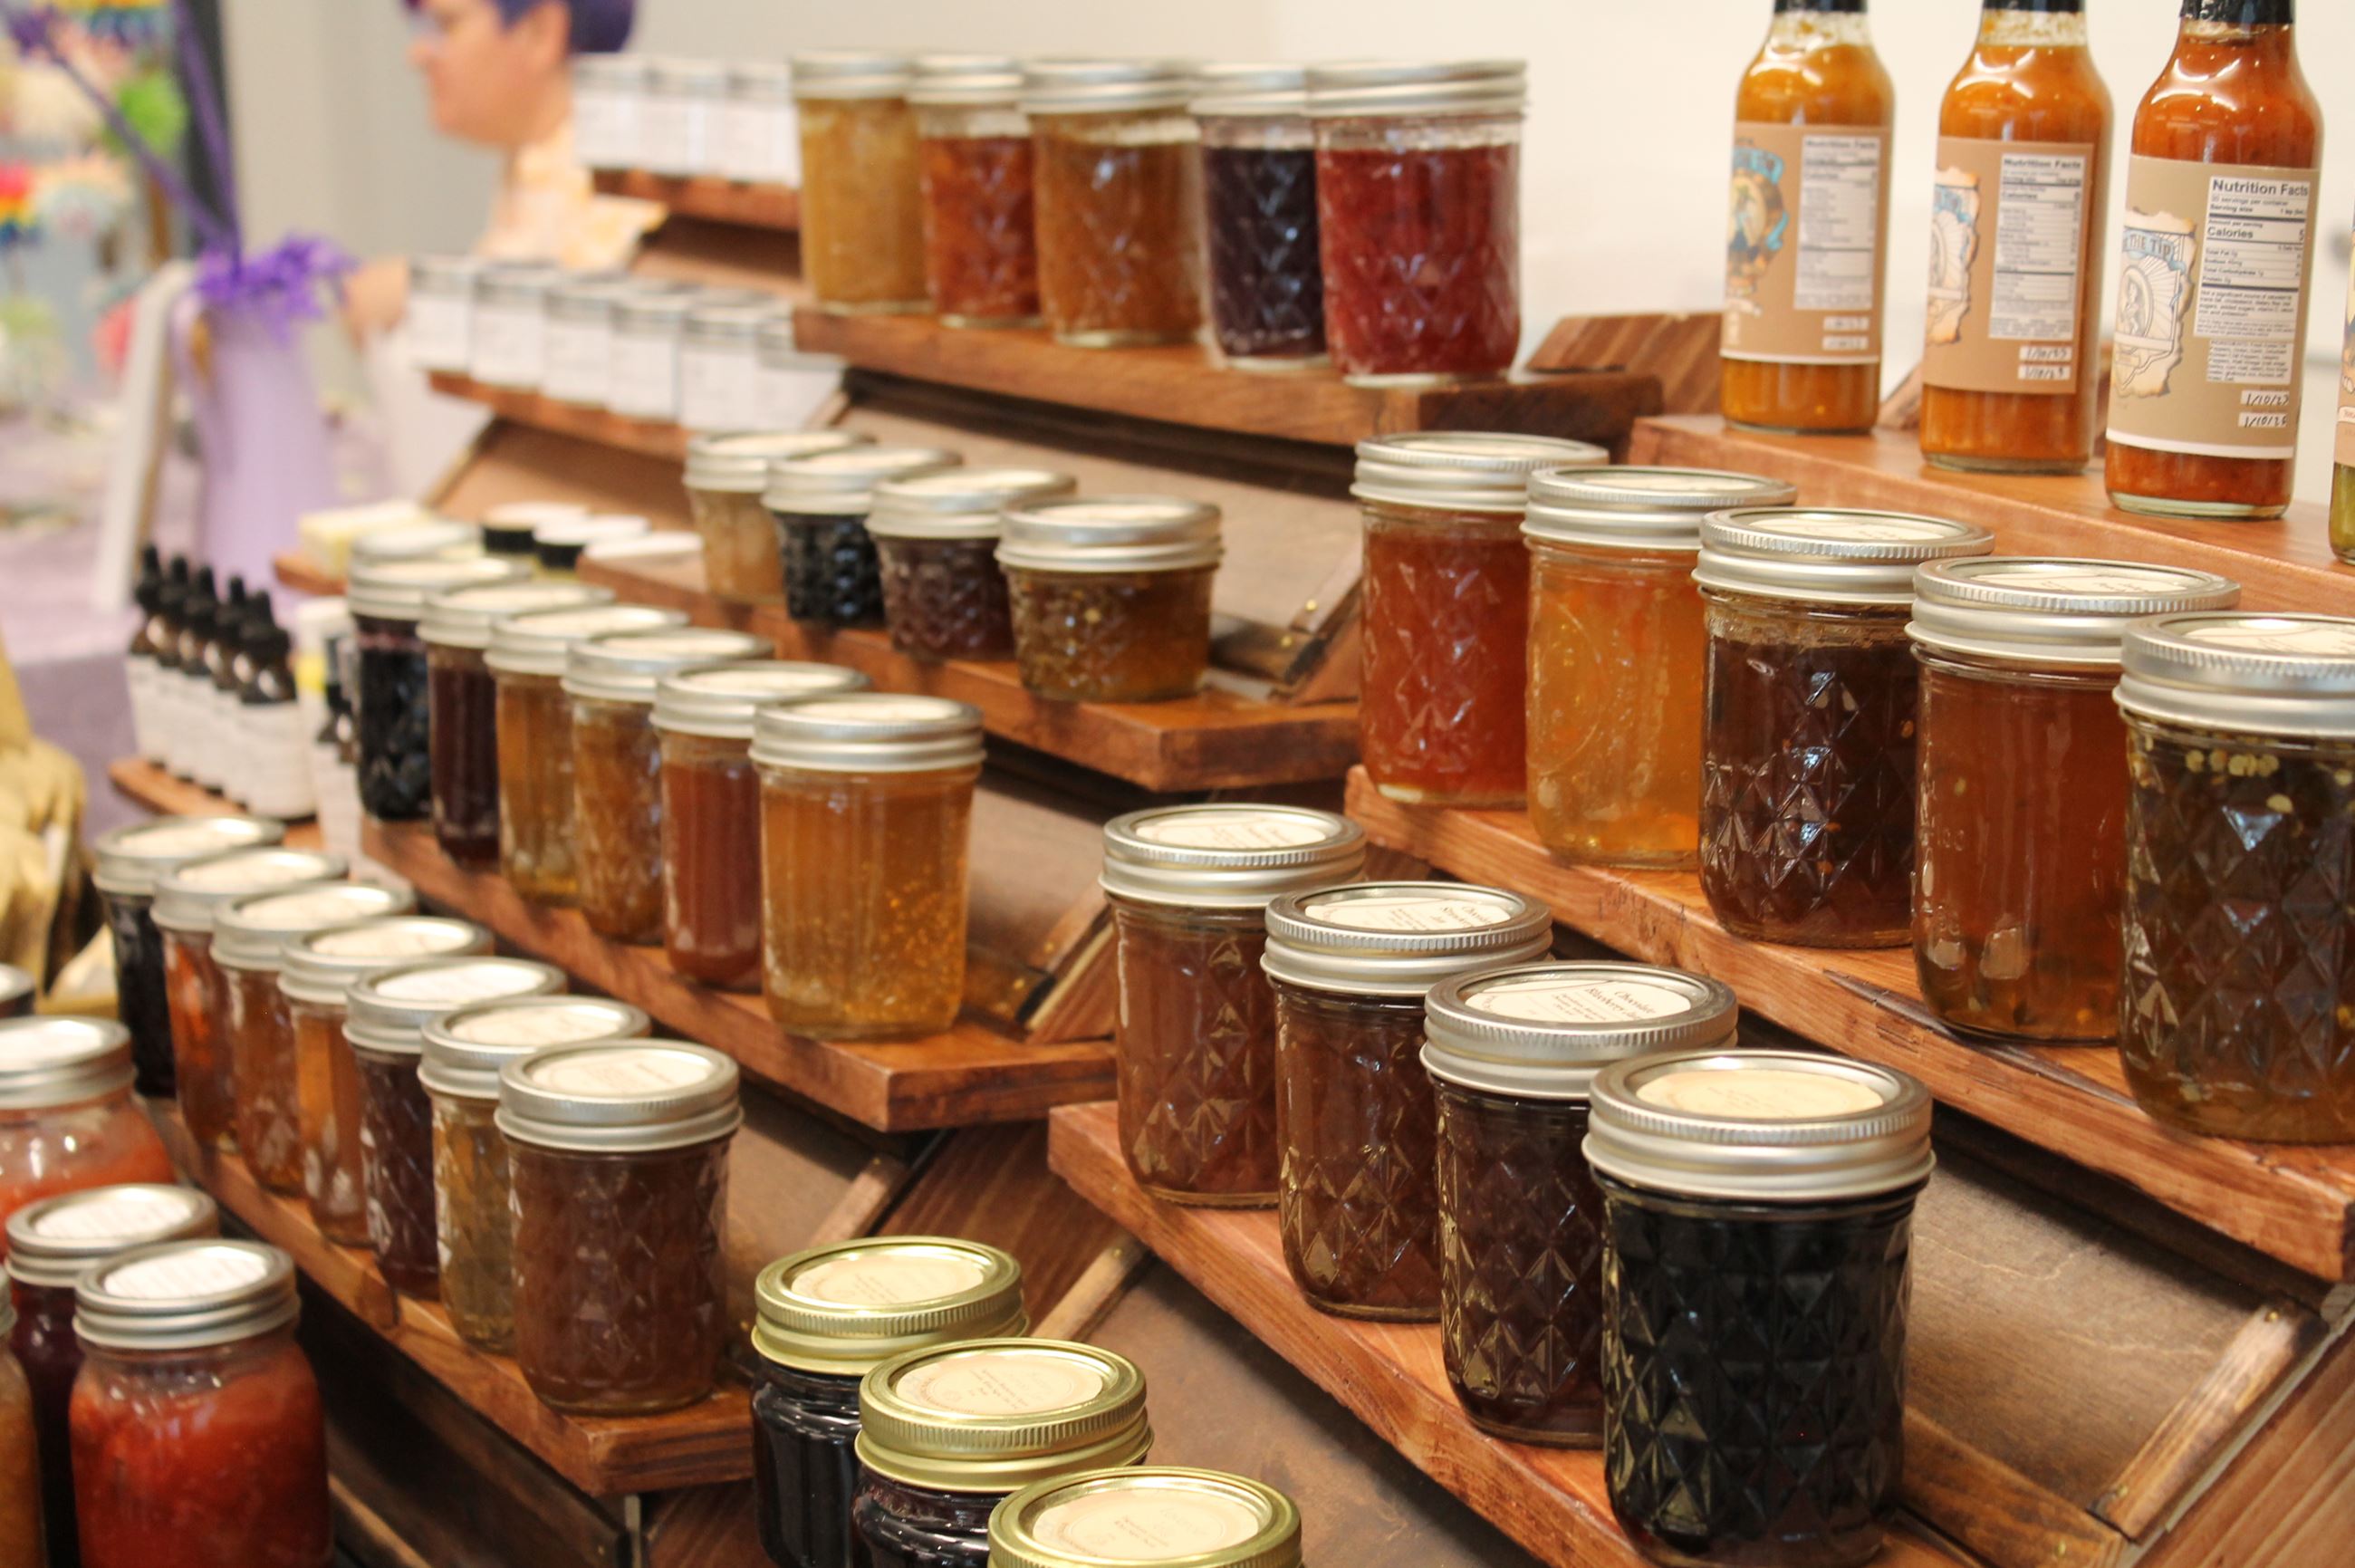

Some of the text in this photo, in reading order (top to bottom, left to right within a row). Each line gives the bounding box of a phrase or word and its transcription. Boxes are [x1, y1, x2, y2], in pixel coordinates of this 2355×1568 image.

[2212, 179, 2309, 197] Nutrition Facts
[2207, 226, 2254, 238] Calories
[2129, 233, 2146, 251] THE
